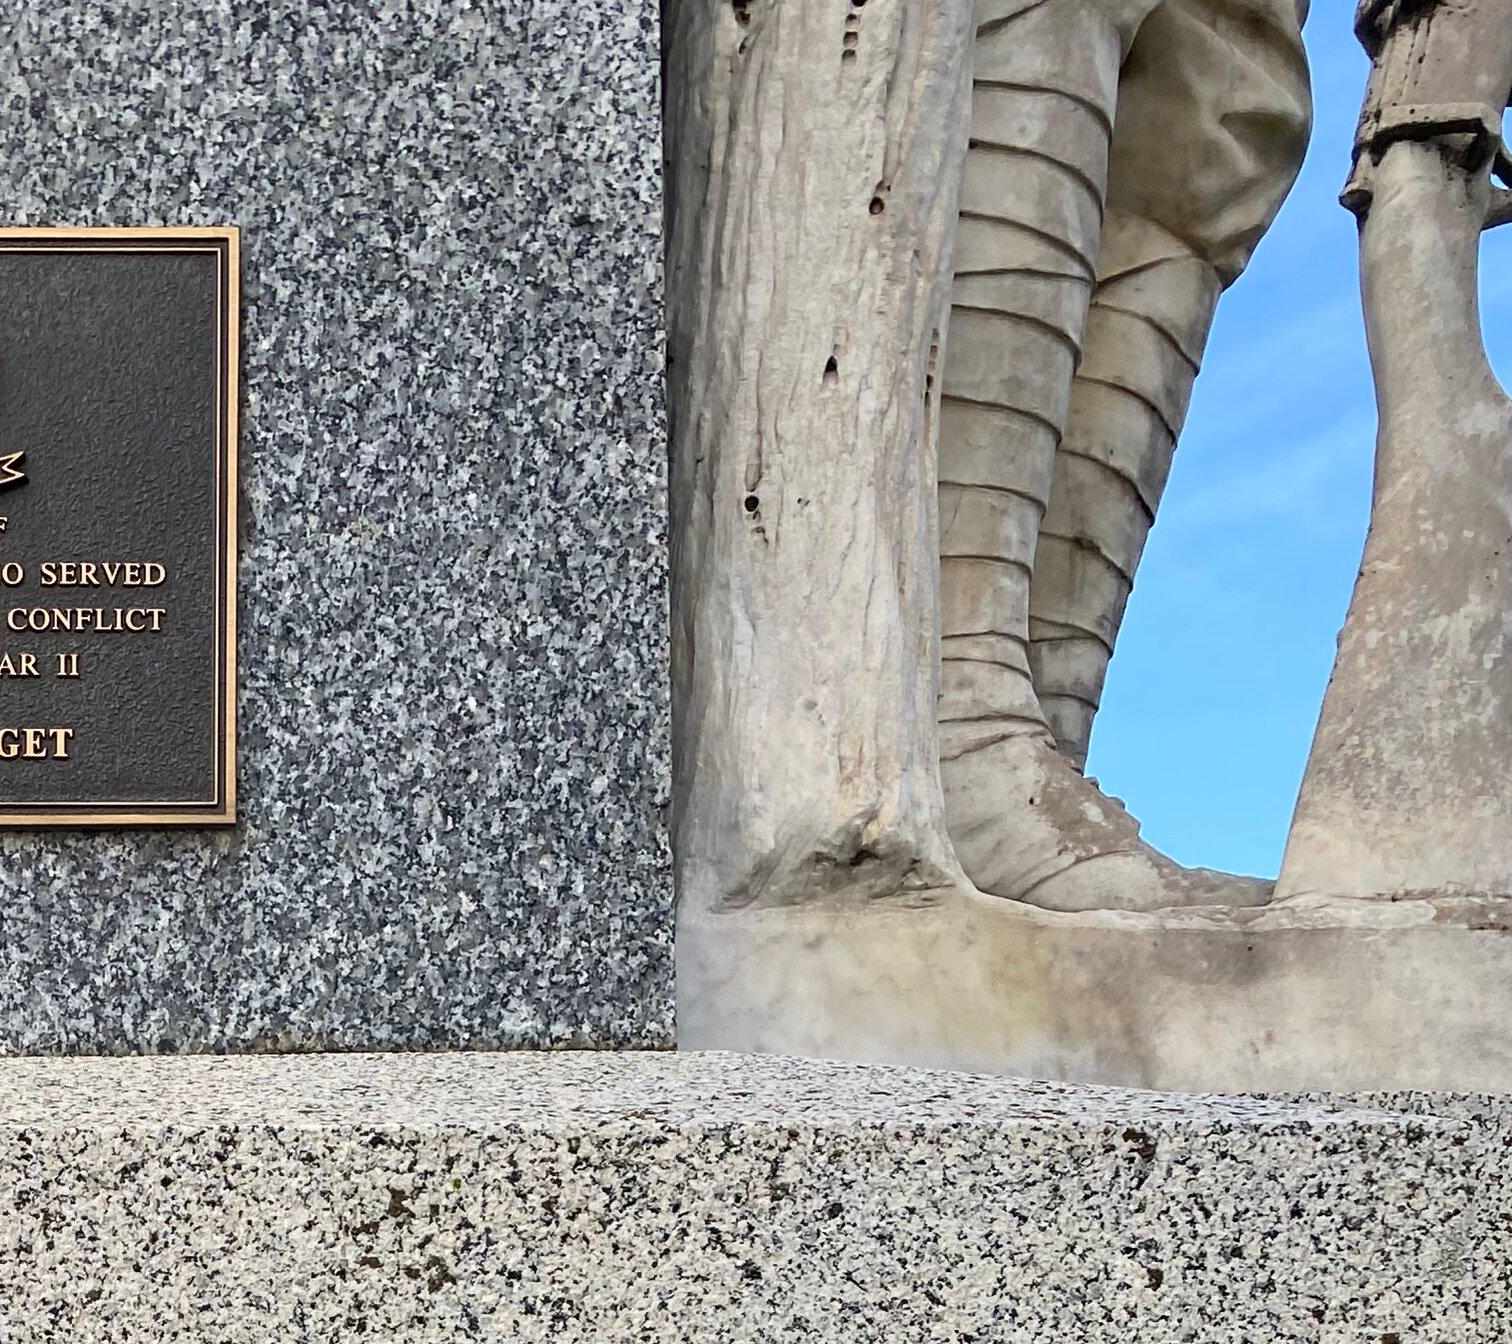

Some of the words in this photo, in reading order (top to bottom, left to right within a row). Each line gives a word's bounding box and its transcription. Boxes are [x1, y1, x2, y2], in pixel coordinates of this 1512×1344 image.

[40, 561, 167, 586] SERVED
[7, 607, 167, 632] CONFLICT
[56, 653, 80, 676] II
